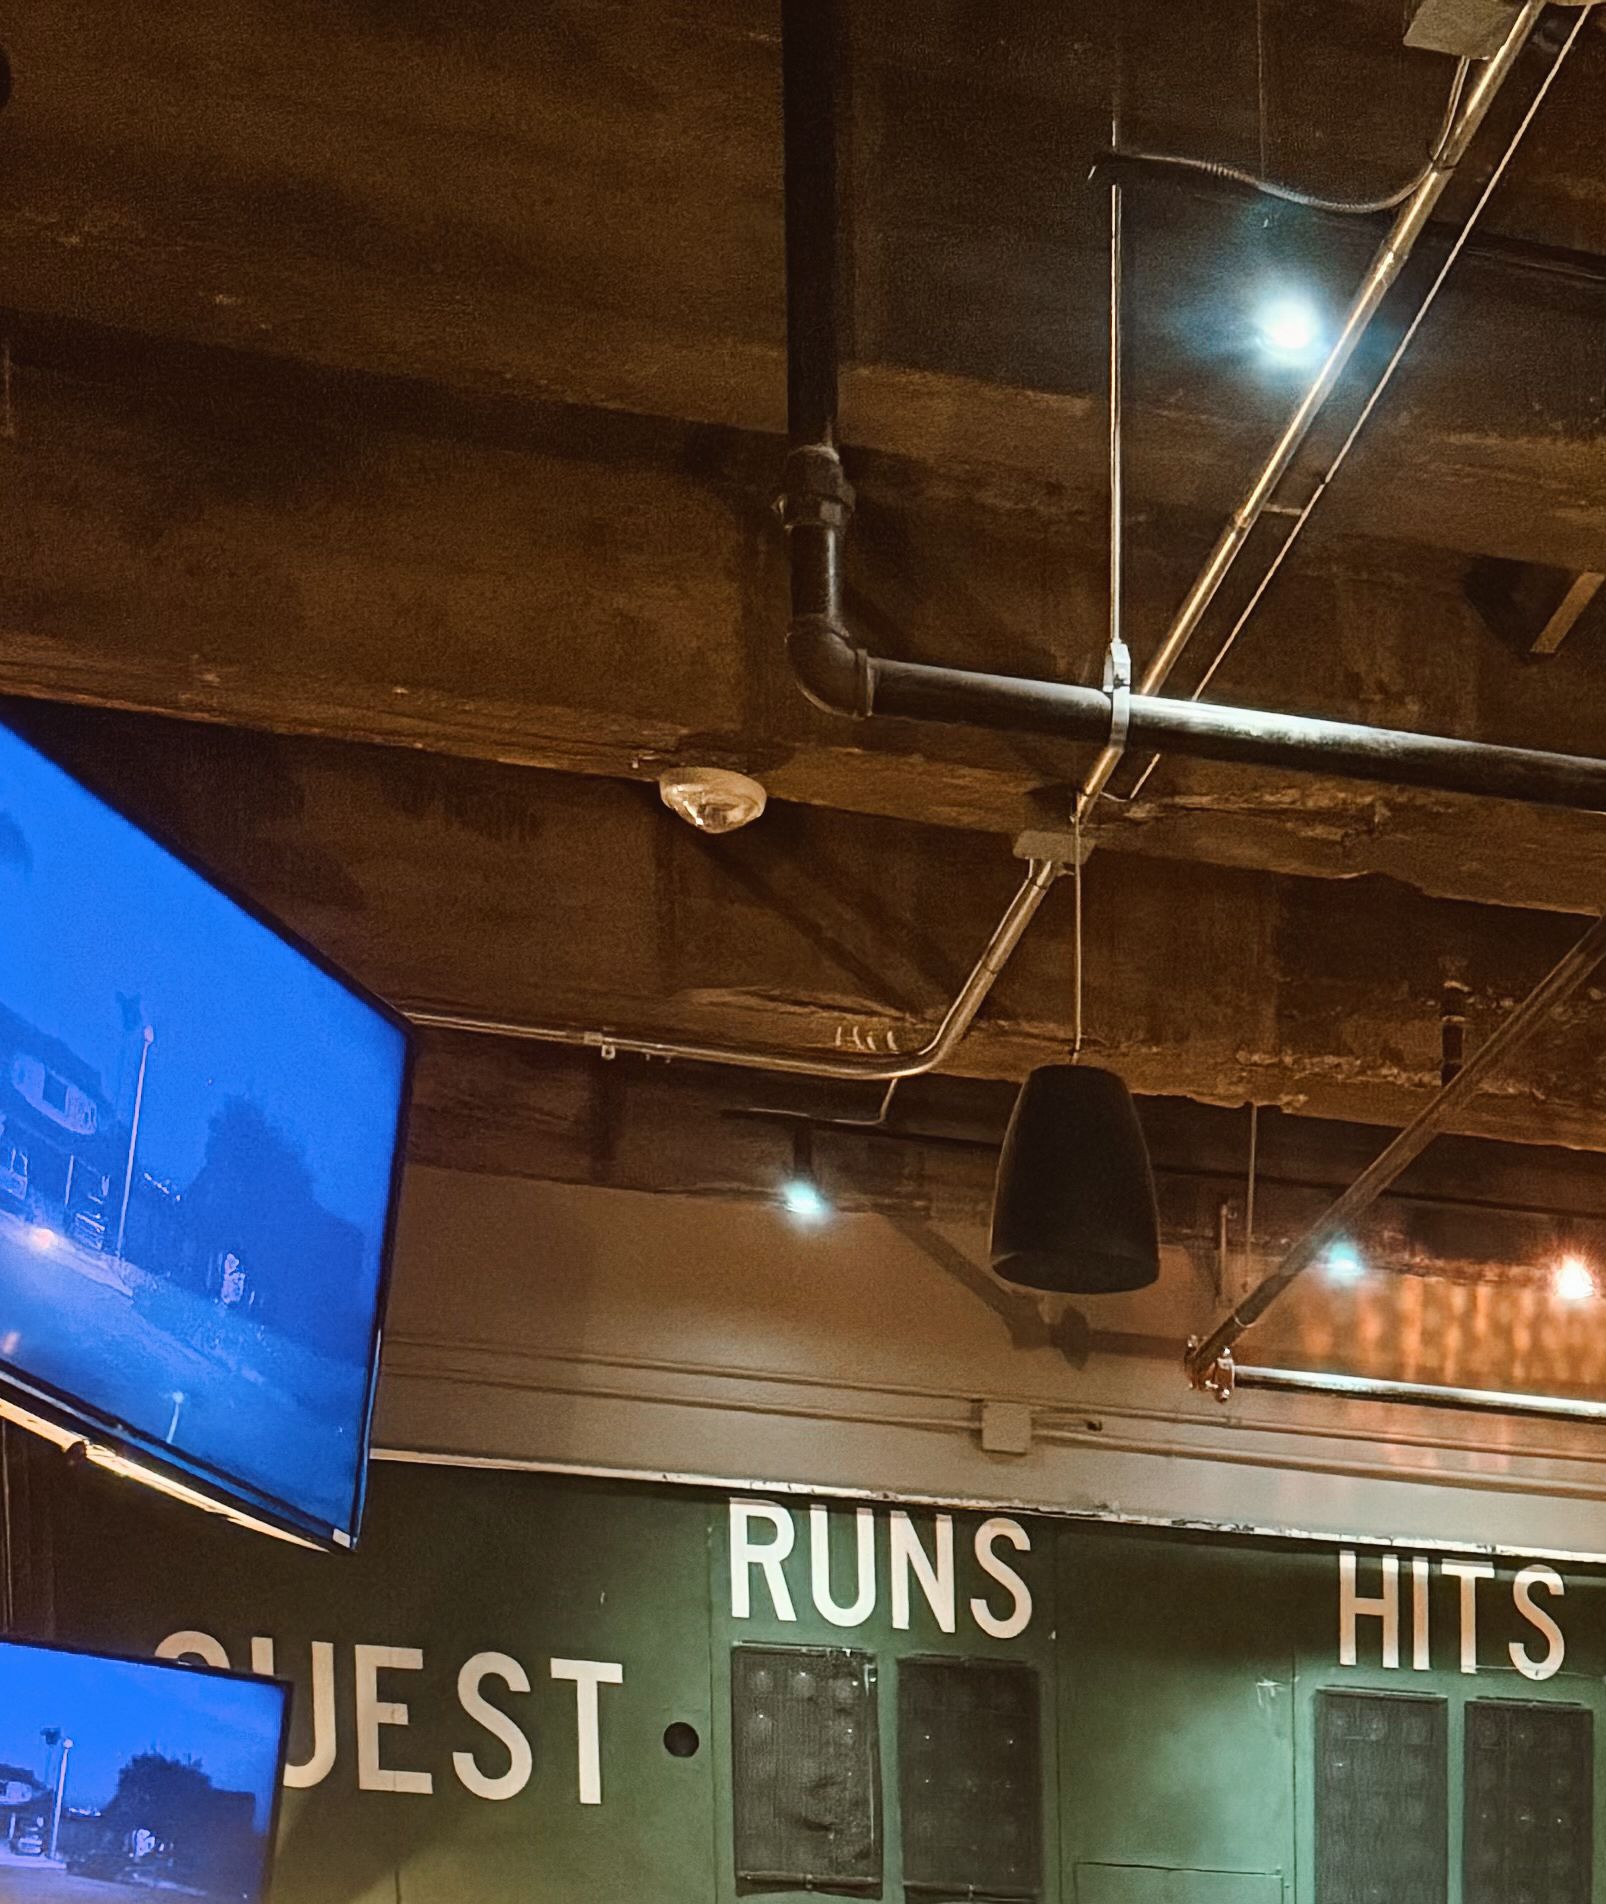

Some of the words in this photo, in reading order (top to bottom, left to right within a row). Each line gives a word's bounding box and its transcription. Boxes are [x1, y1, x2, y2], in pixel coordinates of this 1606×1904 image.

[727, 1496, 1035, 1640] RUNS
[1338, 1550, 1566, 1682] HITS
[153, 1630, 625, 1806] UEST
